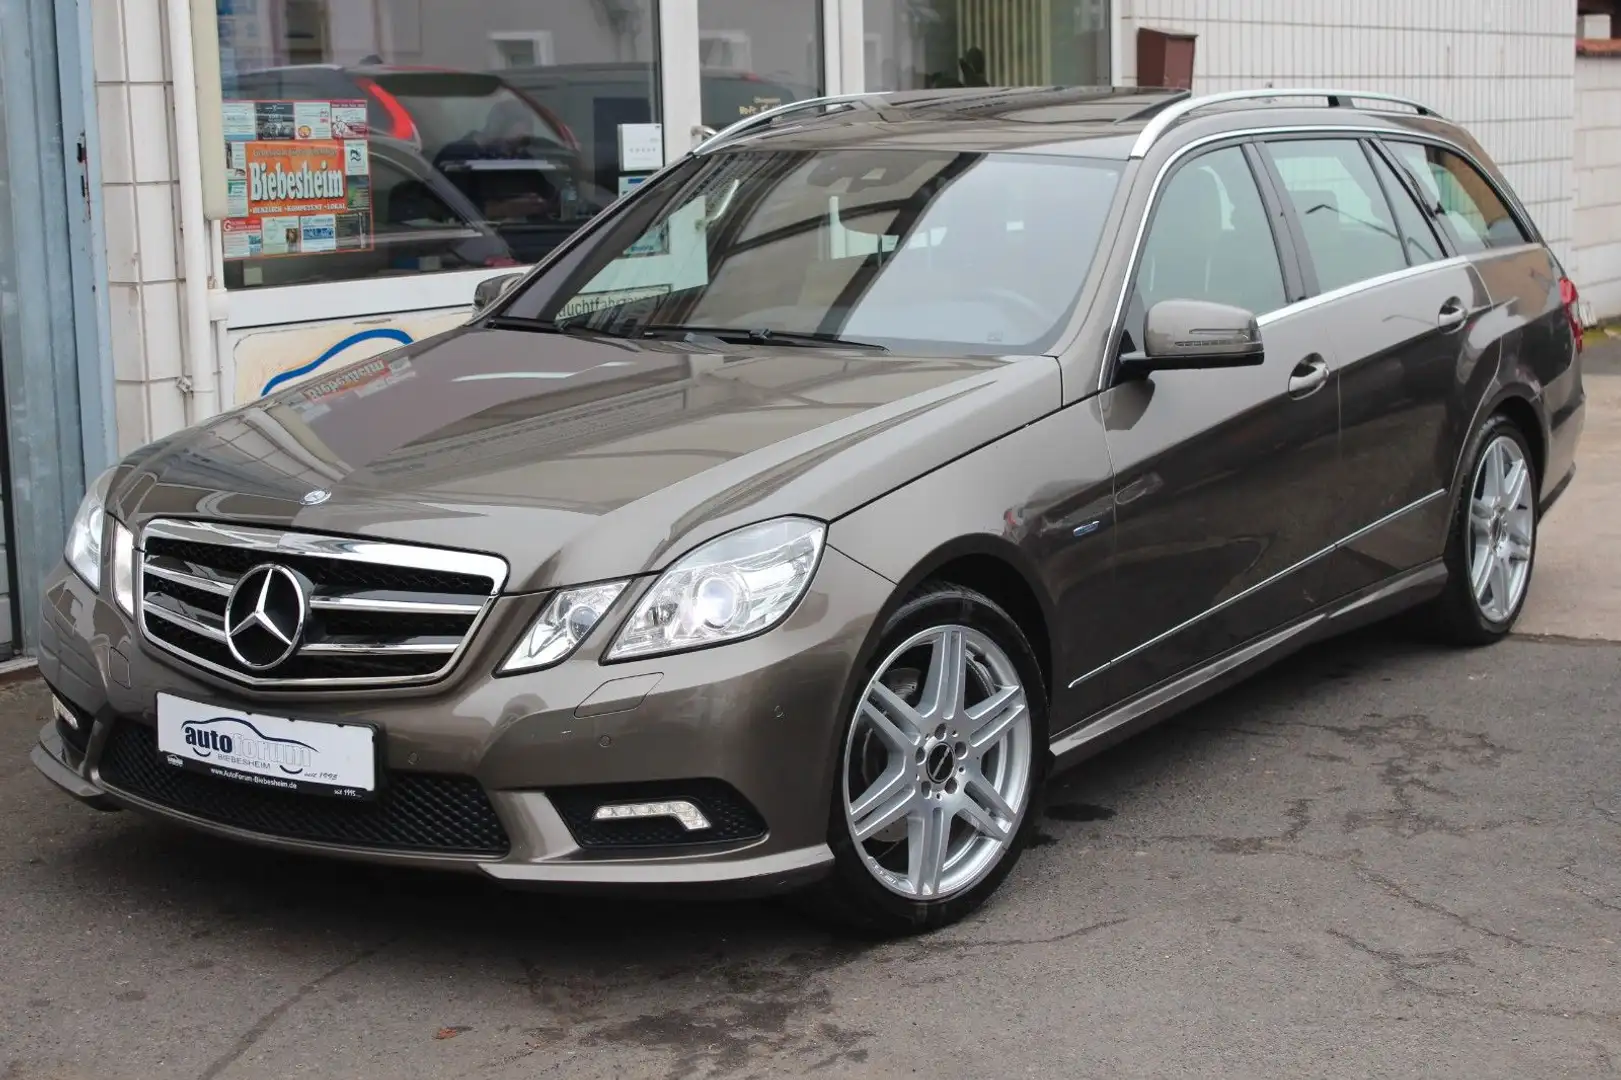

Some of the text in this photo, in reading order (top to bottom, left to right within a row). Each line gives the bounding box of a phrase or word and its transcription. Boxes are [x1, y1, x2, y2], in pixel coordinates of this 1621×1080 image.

[249, 160, 344, 201] Biebesheim
[327, 202, 345, 210] LOKAL
[217, 753, 271, 769] BIEBESHEIM
[210, 767, 298, 790] www.AutoForum-Biebesheim.de
